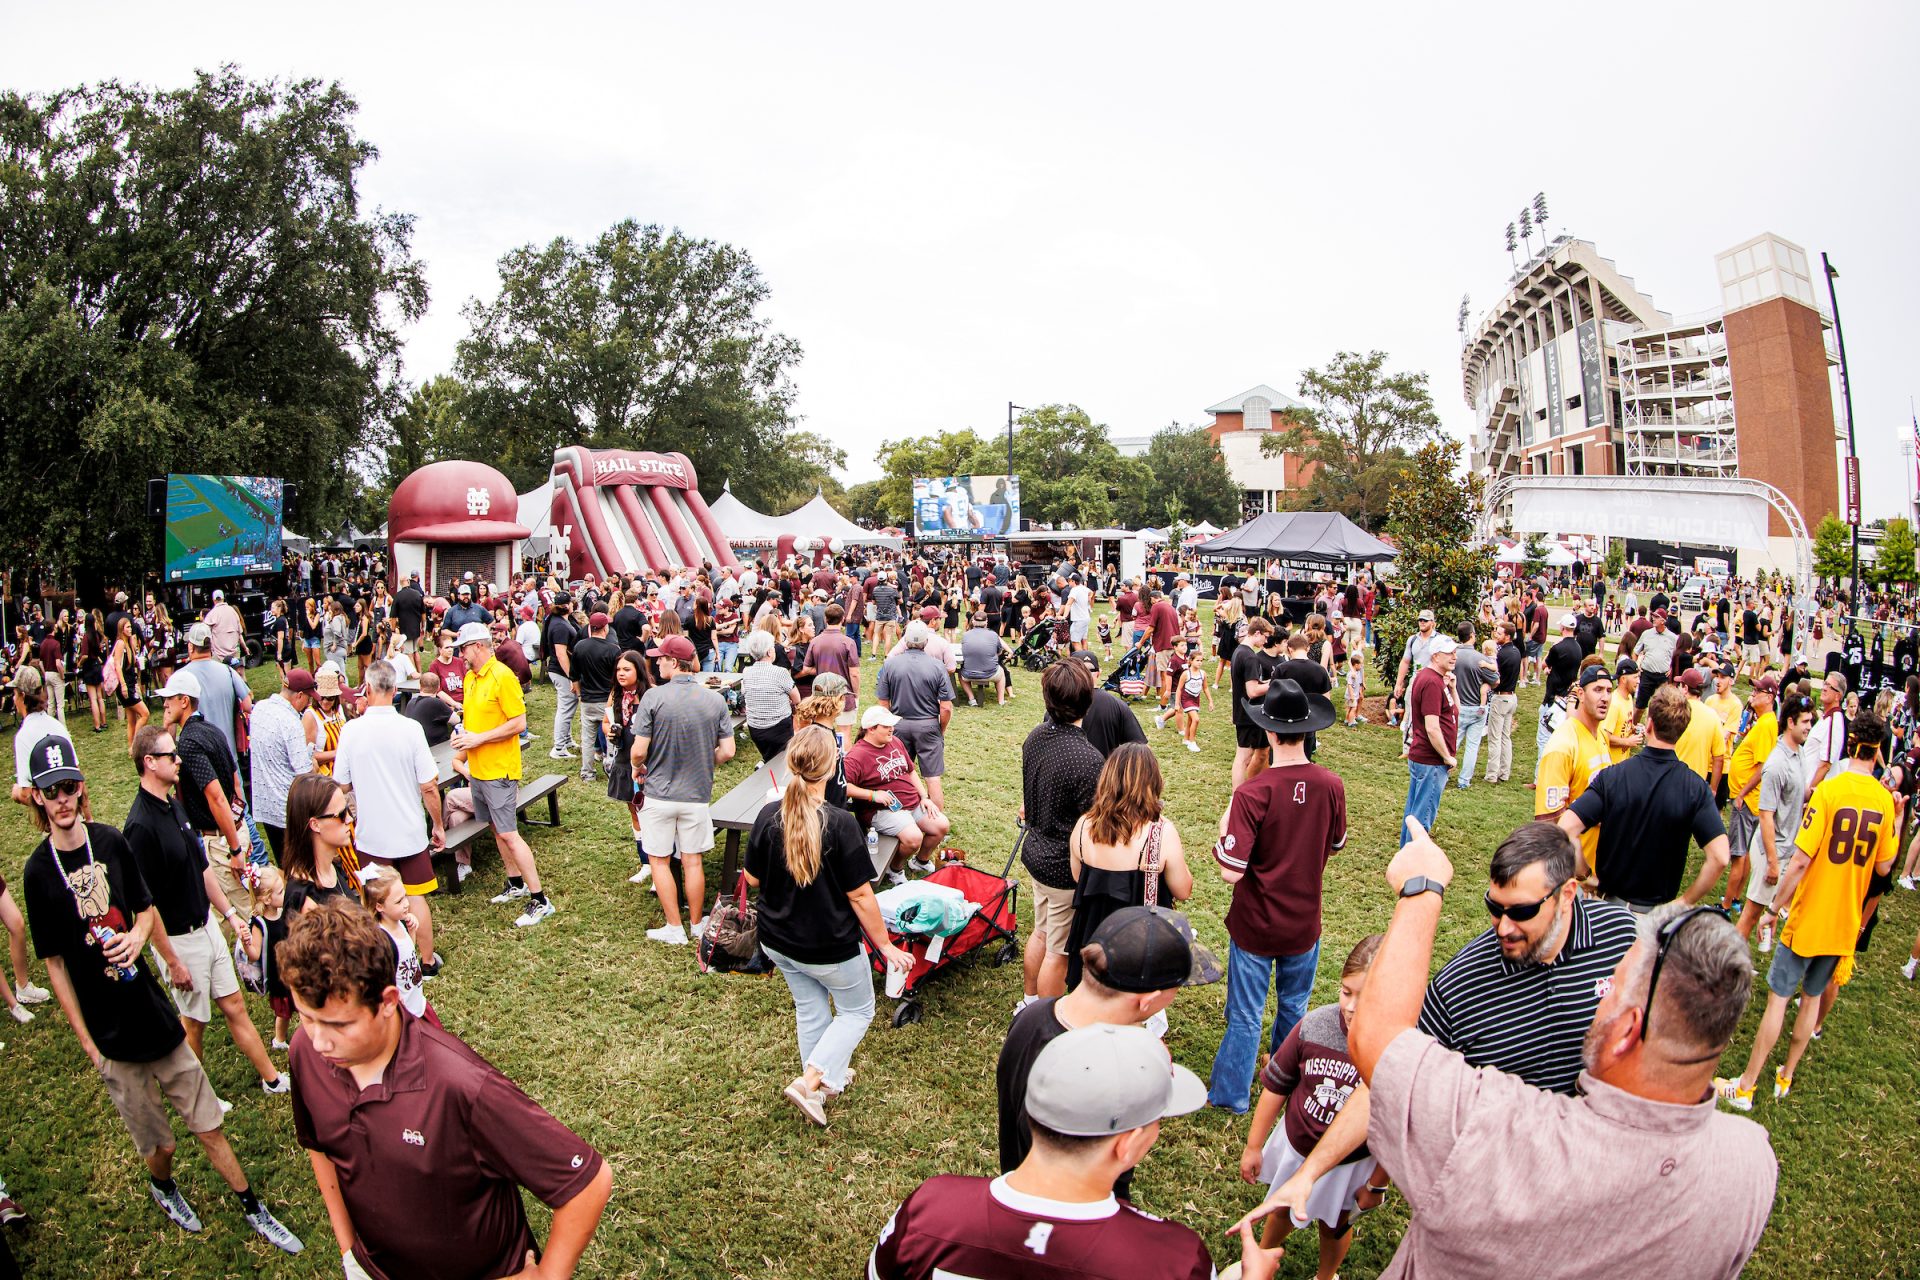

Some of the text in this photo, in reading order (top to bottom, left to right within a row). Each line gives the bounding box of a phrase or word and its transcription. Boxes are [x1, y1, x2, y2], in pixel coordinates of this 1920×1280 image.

[1548, 345, 1560, 418] HAIL STATE
[596, 458, 685, 477] HAIL STATE
[729, 540, 773, 549] HAIL STATE
[883, 757, 906, 775] STATE
[1828, 808, 1884, 867] 85
[1304, 1058, 1358, 1084] MISSISSIPPI
[1303, 1095, 1335, 1125] BULLD
